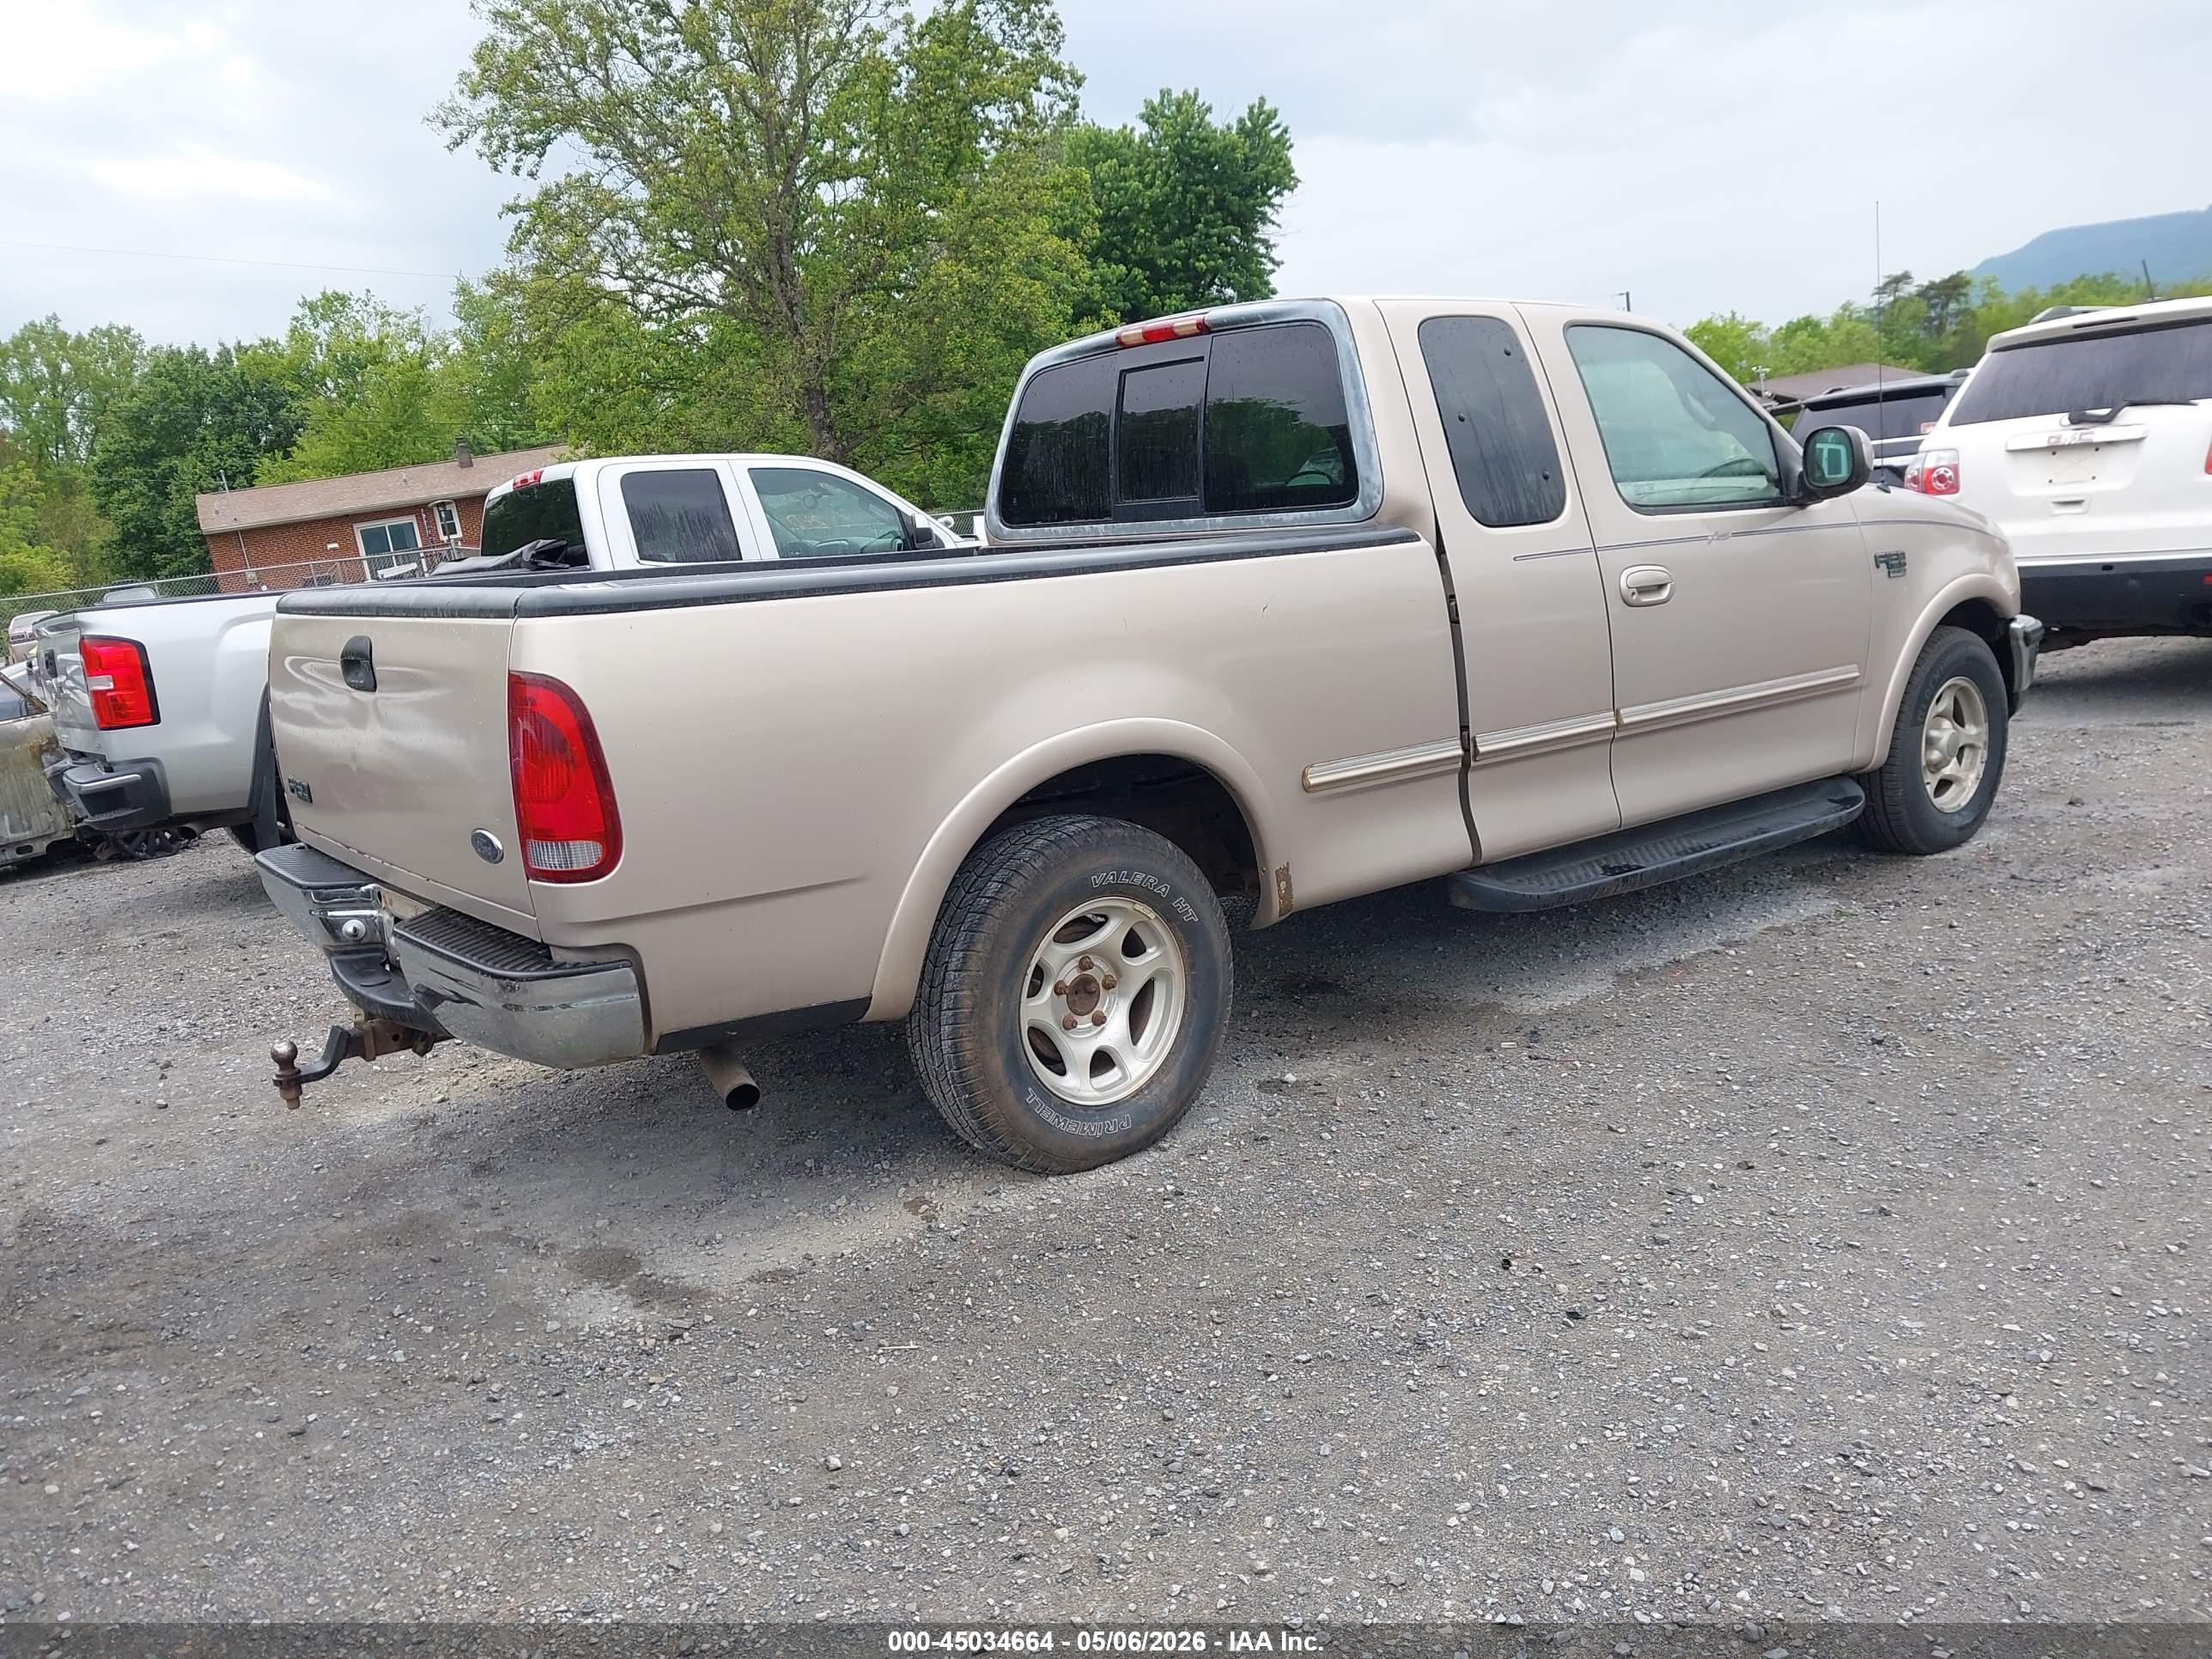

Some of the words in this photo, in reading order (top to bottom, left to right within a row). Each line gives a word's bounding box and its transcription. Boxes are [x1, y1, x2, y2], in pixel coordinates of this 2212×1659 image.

[1091, 871, 1170, 898] VALERA
[1172, 896, 1199, 922] HT
[1025, 1086, 1132, 1138] PRIMEWELL
